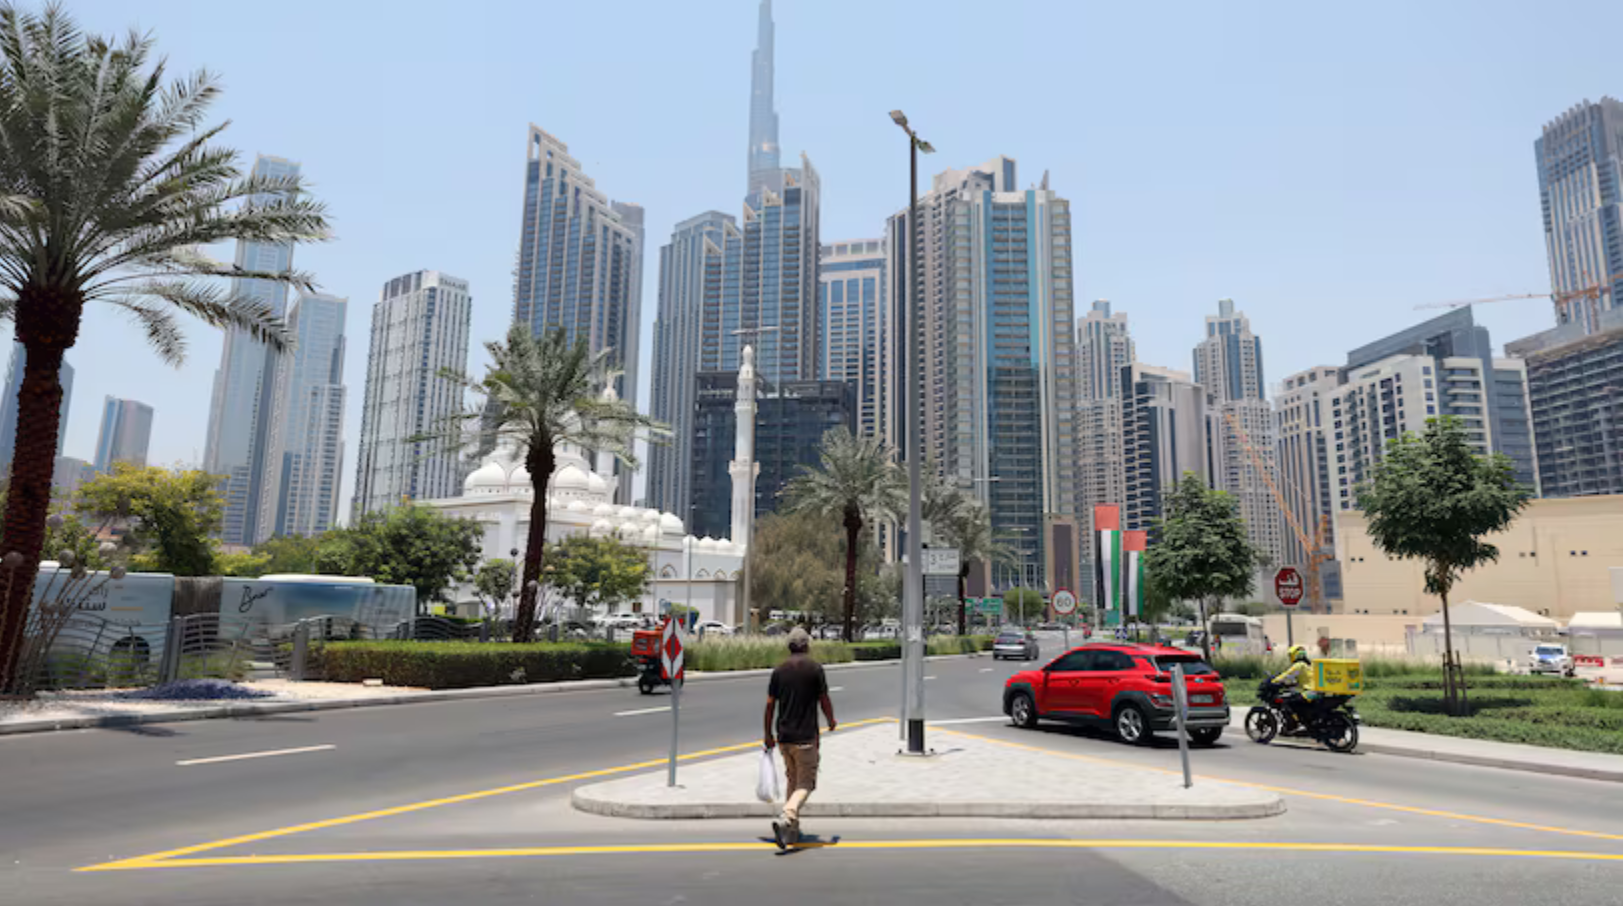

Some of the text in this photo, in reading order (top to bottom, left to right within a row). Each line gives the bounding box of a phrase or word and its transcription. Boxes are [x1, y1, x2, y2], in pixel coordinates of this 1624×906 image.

[1279, 571, 1299, 585] قف
[1278, 587, 1301, 599] STOP
[1056, 596, 1072, 608] 60
